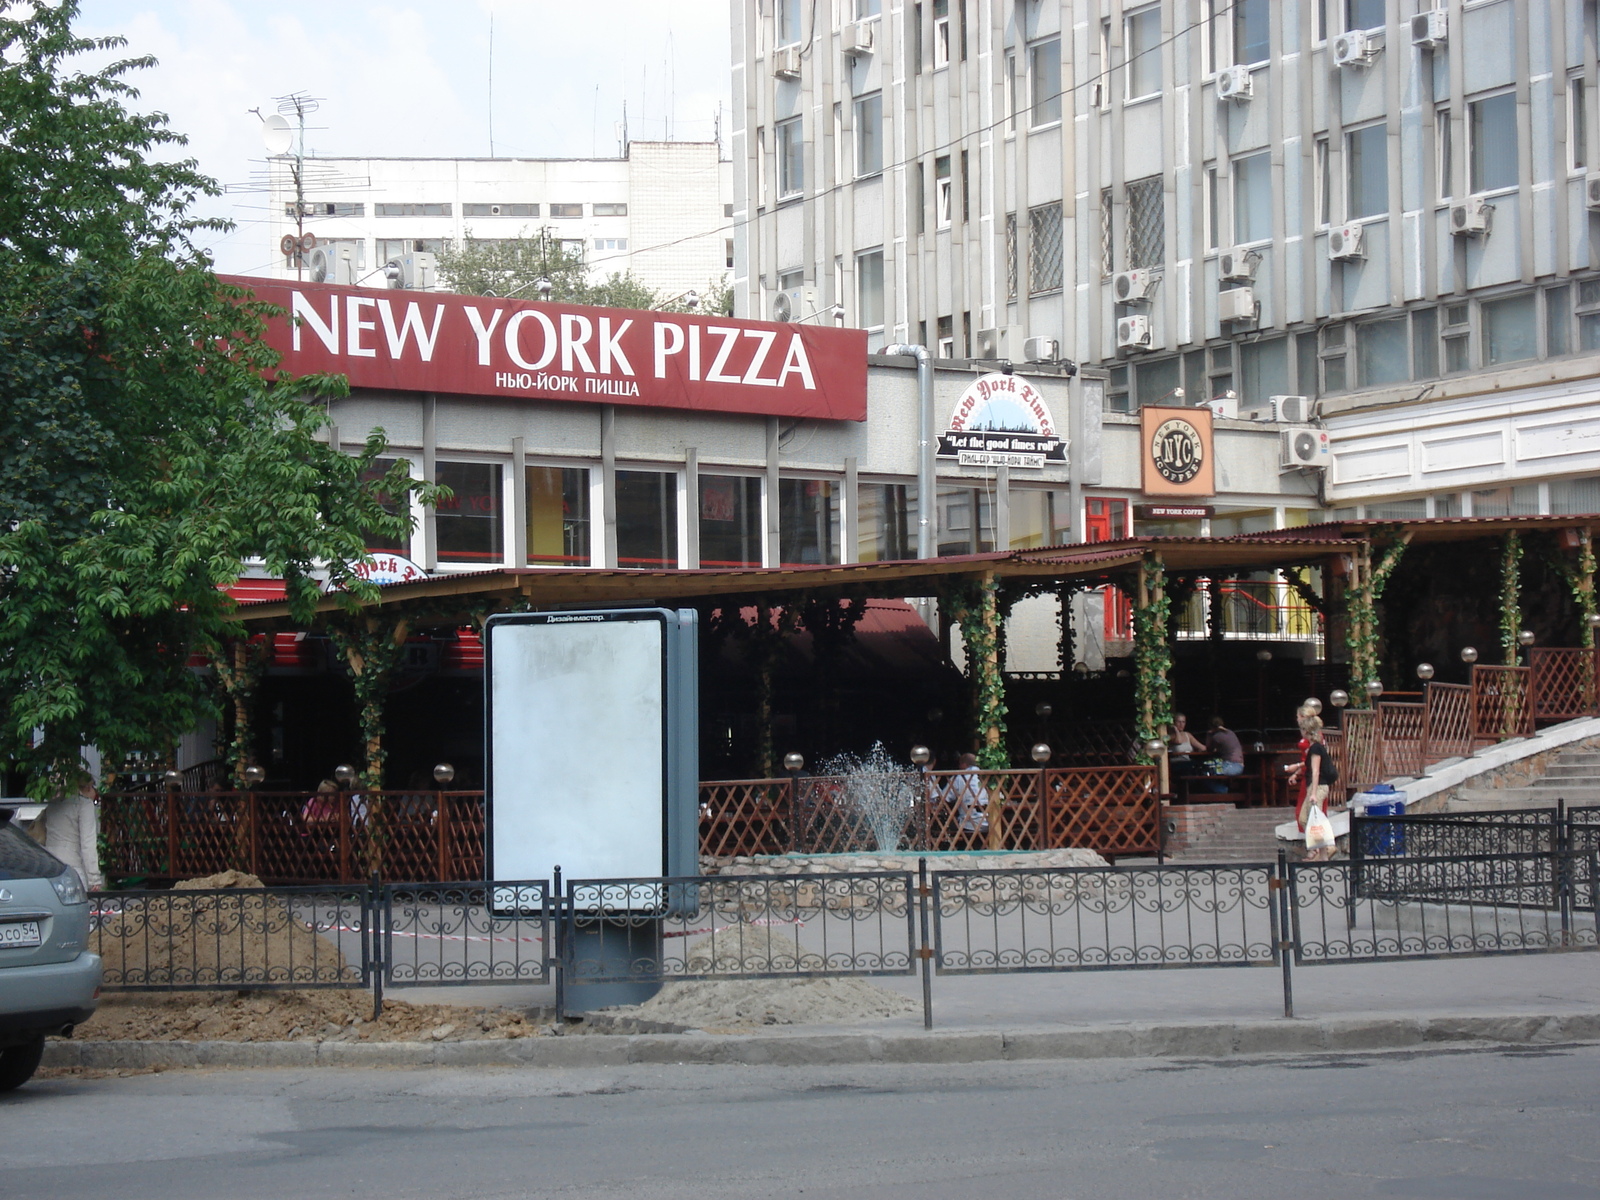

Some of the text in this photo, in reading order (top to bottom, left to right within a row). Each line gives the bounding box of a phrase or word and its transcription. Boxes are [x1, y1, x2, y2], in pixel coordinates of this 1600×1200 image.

[291, 290, 817, 391] NEW YORK PIZZA
[495, 371, 640, 397] НЬЮ-ЙОРК ПИЦЦА
[951, 377, 1054, 437] New York Times
[969, 438, 984, 448] the
[986, 438, 1009, 451] good
[1011, 439, 1036, 450] times
[1154, 421, 1201, 449] NEW YORK
[1163, 434, 1191, 467] NYC
[1156, 460, 1199, 482] COFFEE
[1183, 508, 1206, 516] COFFEE
